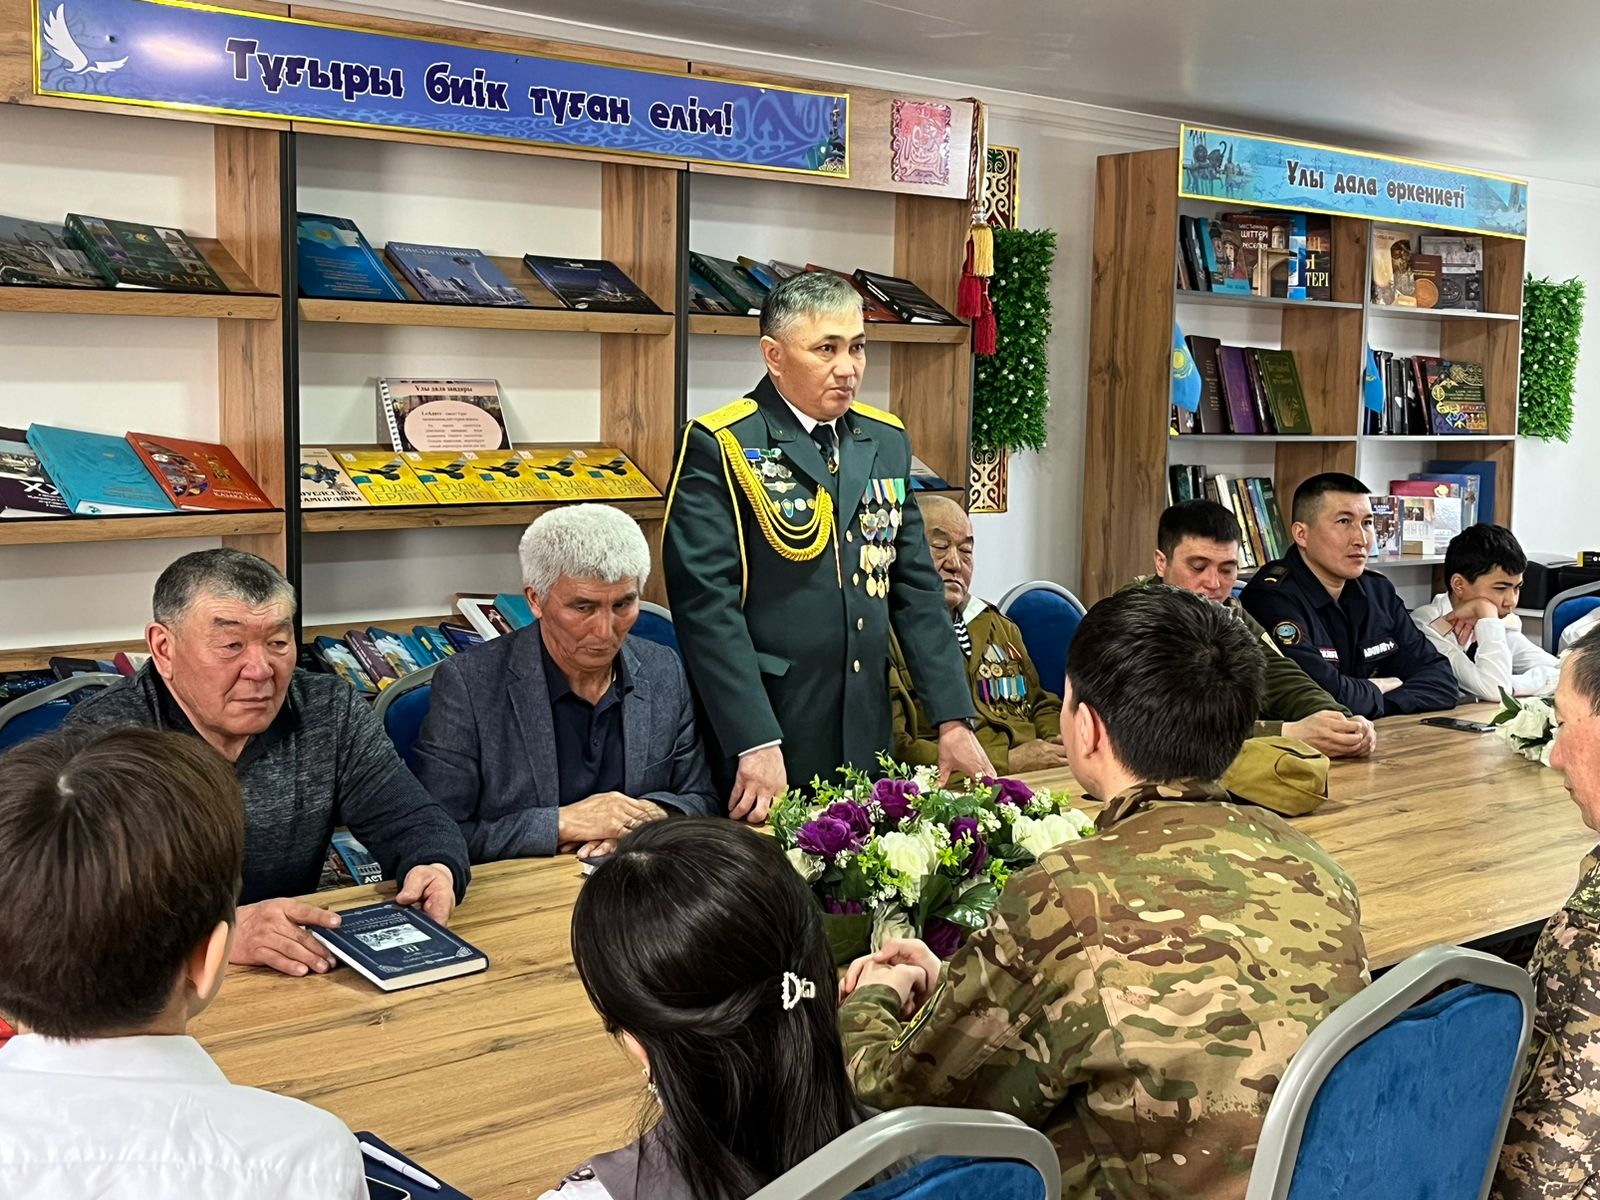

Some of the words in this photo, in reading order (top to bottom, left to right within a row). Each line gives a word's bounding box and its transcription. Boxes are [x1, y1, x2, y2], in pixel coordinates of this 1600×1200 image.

[226, 37, 405, 102] Тұғыры
[424, 62, 509, 111] биік
[529, 86, 631, 126] туған
[649, 96, 734, 137] елім!
[1285, 158, 1324, 189] Ұлы
[1333, 171, 1378, 197] дала
[1386, 178, 1466, 209] өркениеті
[120, 266, 219, 288] АСТАНА
